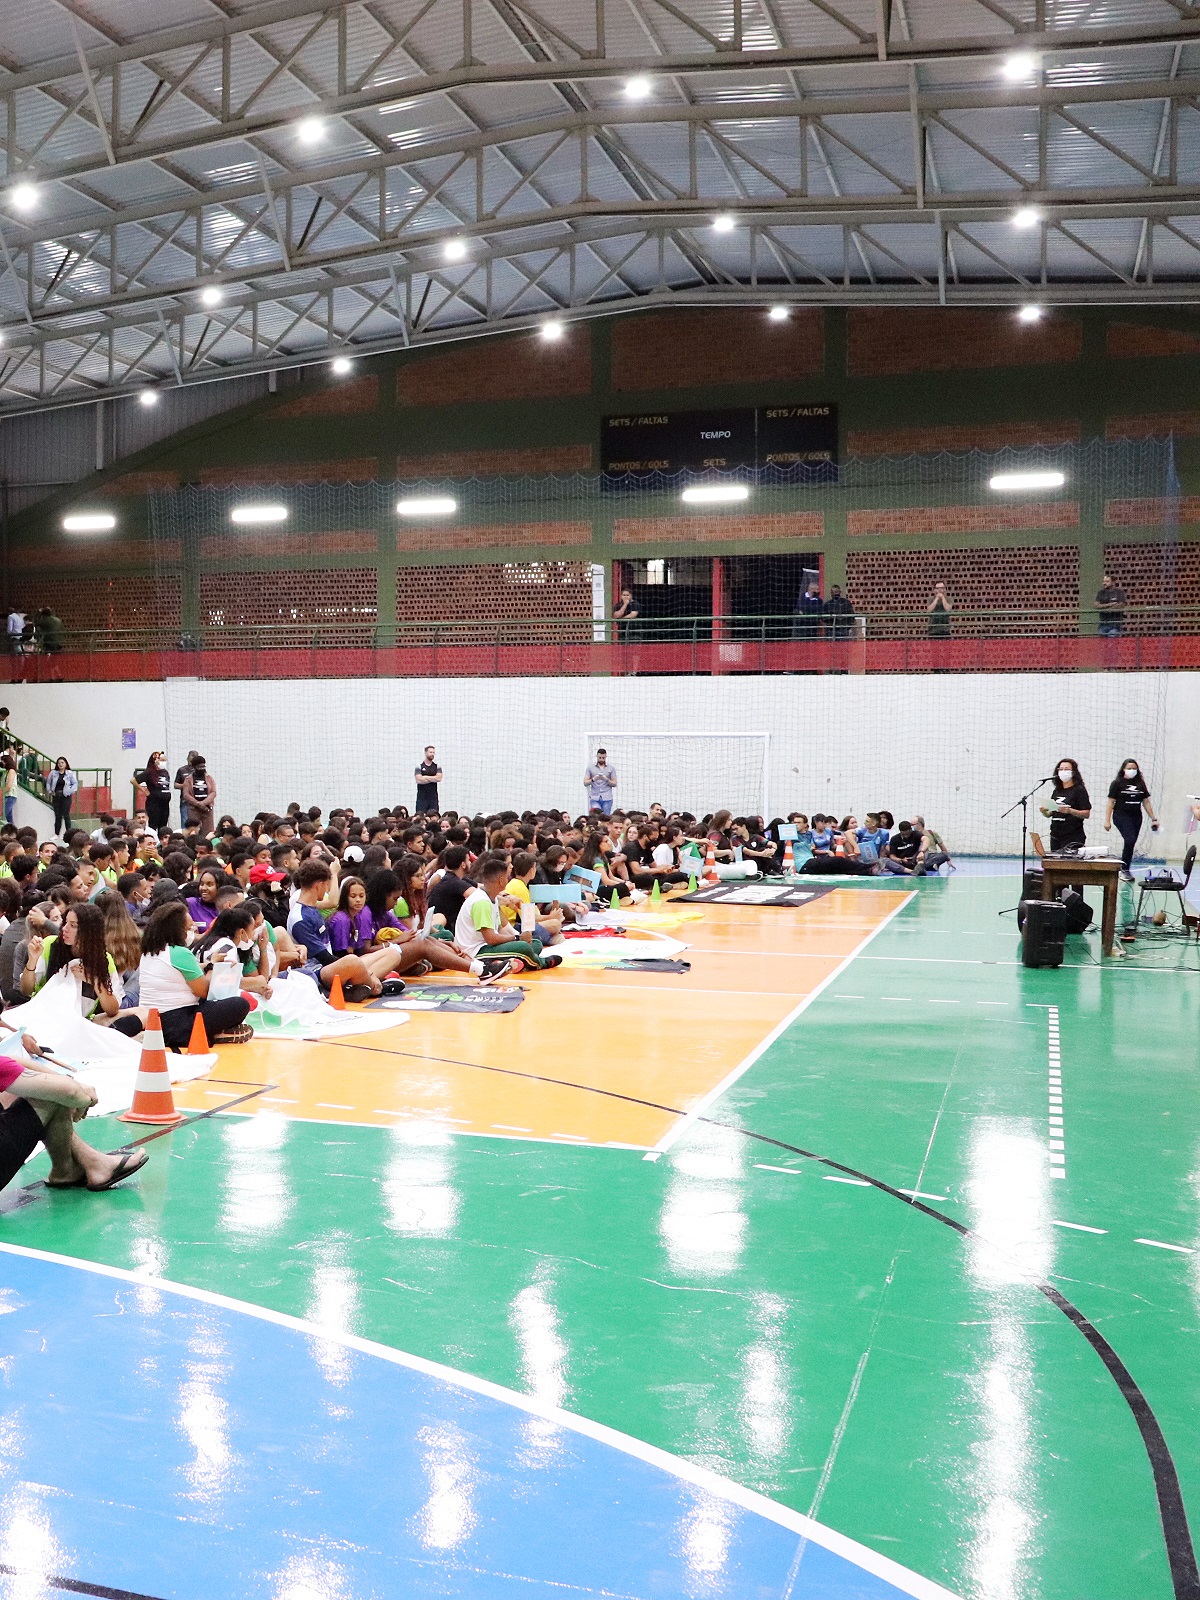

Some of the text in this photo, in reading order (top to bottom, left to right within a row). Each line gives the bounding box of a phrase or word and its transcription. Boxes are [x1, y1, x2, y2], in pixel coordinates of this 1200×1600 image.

[766, 409, 789, 418] SETS
[797, 407, 830, 416] FALTAS
[609, 418, 630, 427] SETS
[638, 416, 669, 425] FALTAS
[700, 430, 732, 440] TEMPO
[703, 458, 727, 467] SETS
